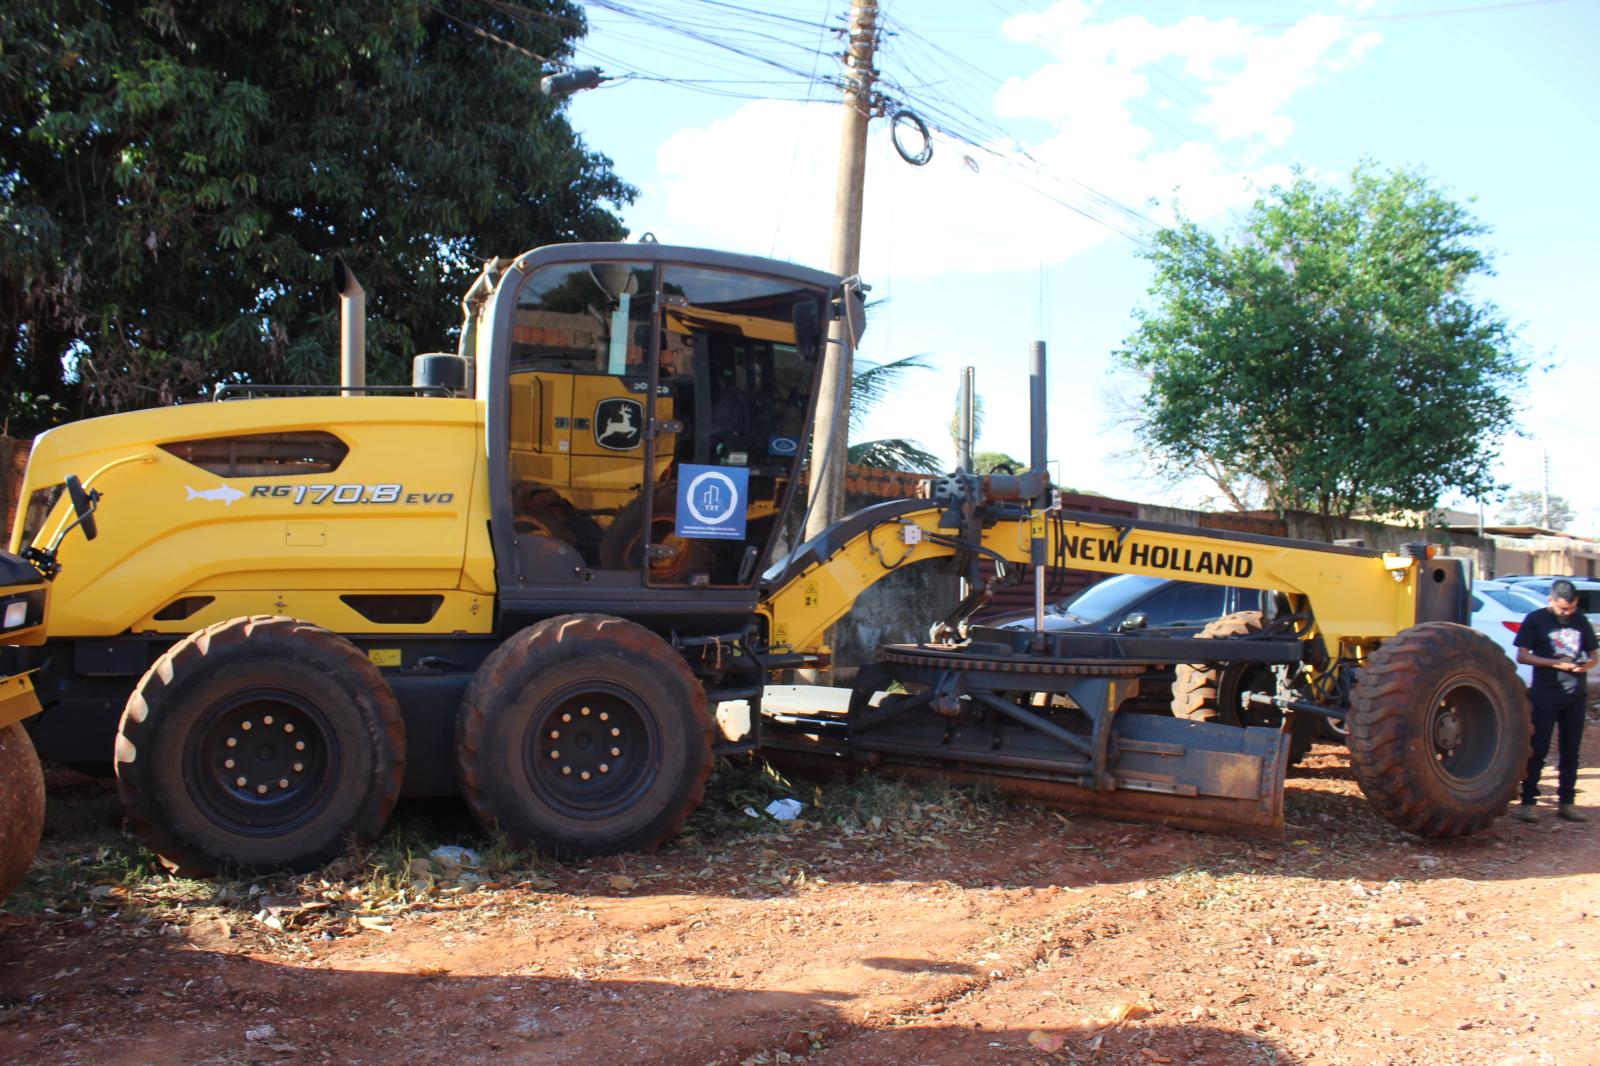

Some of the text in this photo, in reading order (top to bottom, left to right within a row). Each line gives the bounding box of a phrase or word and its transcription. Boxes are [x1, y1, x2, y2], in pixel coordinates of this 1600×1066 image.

[405, 493, 453, 503] EVO
[1063, 535, 1253, 578] NEW HOLLAND
